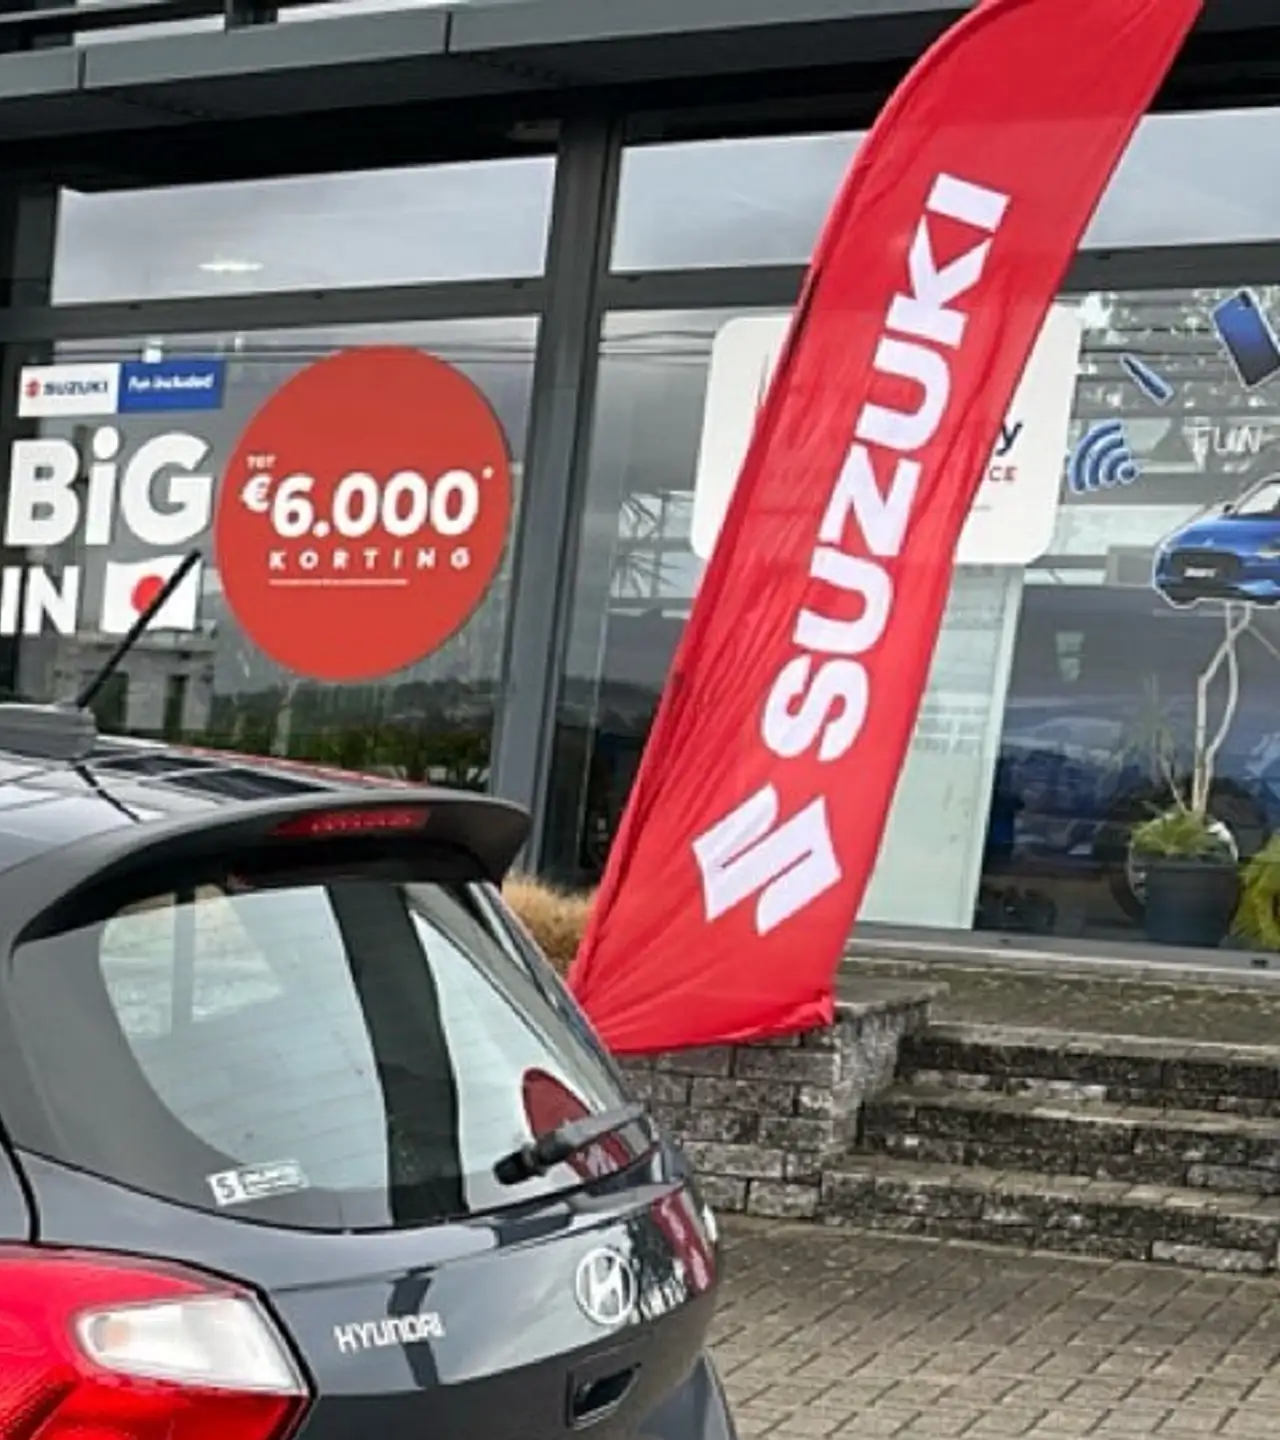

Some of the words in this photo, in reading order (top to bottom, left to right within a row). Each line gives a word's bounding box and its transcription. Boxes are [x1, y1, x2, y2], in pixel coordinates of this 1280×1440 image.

[43, 380, 108, 396] SUZUKI
[759, 171, 1012, 763] SUZUKI
[268, 546, 470, 571] KORTING
[0, 565, 80, 636] IN
[333, 1312, 446, 1354] HYUNDAI
